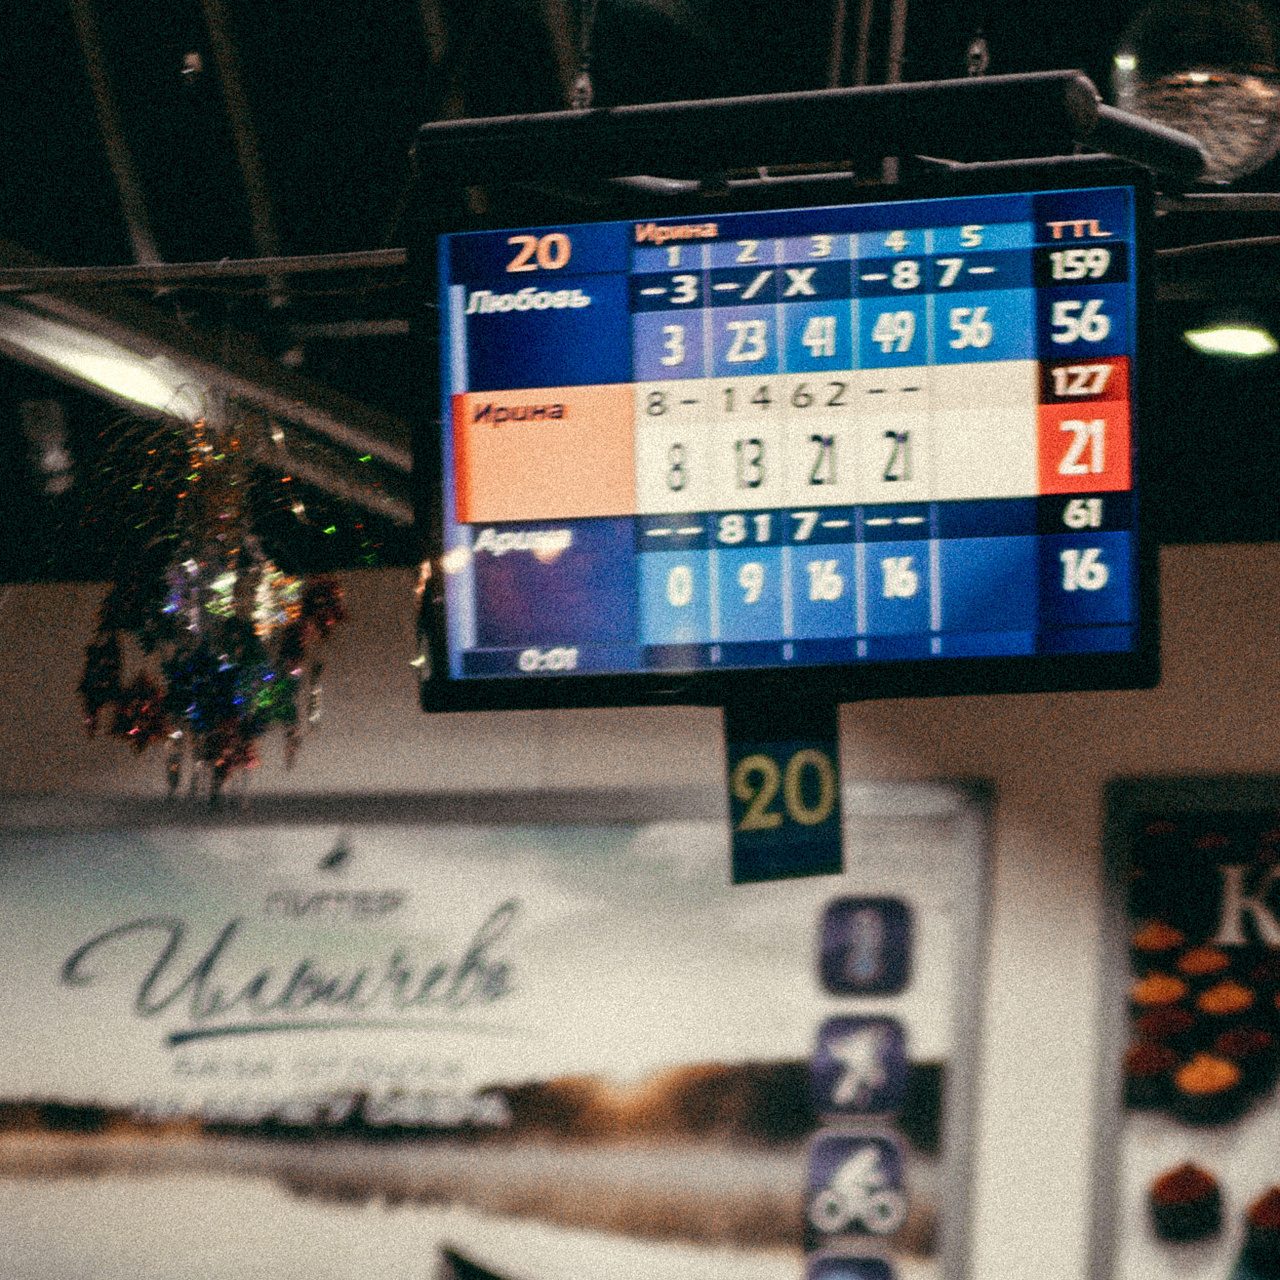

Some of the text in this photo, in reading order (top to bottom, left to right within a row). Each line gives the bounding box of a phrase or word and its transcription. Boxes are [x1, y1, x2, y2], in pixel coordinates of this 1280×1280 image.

[635, 223, 718, 244] Ирина
[667, 225, 984, 267] 1 2 3 4 5
[1046, 219, 1113, 239] TTL
[506, 233, 571, 273] 20
[1049, 248, 1111, 280] 159
[466, 288, 592, 314] Любовь
[1051, 299, 1112, 344] 56
[661, 307, 993, 366] 3 23 41 49 56
[1052, 364, 1111, 397] 127
[472, 404, 565, 428] Ирина
[666, 430, 911, 492] 8 13 21 21
[1058, 420, 1105, 476] 21
[1063, 498, 1102, 529] 61
[667, 556, 918, 607] 0 9 16 16
[1060, 548, 1108, 592] 16
[732, 749, 836, 832] 20
